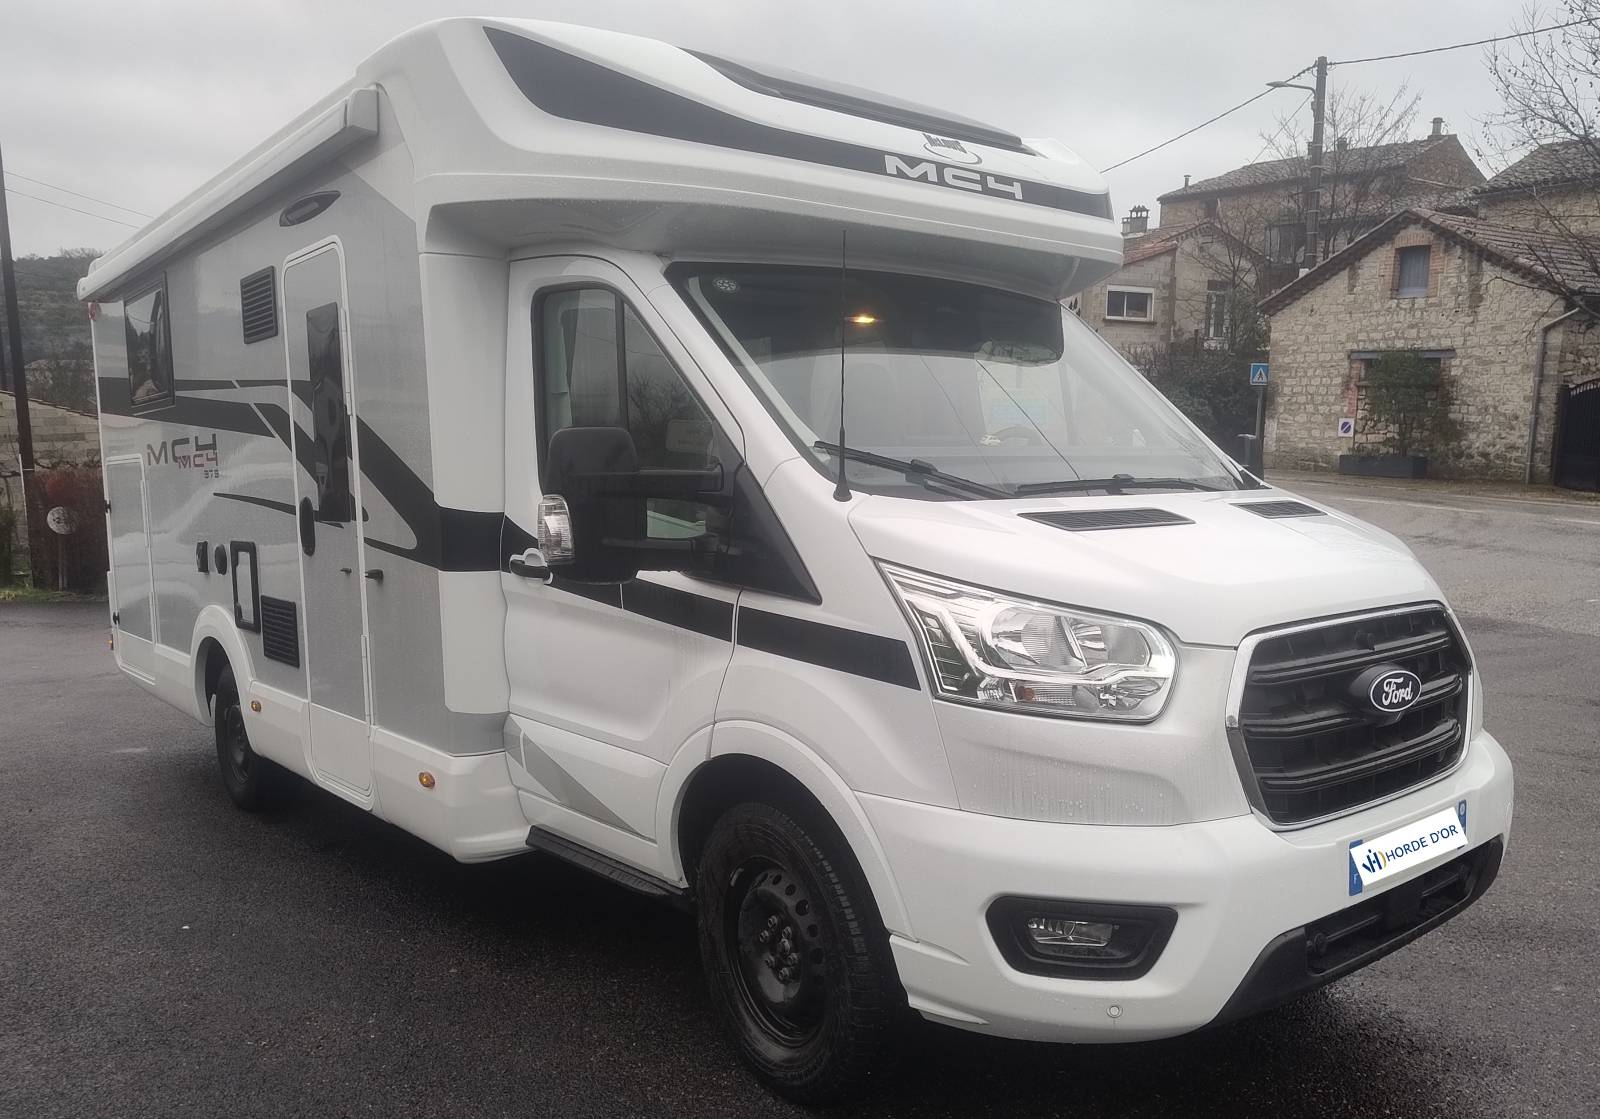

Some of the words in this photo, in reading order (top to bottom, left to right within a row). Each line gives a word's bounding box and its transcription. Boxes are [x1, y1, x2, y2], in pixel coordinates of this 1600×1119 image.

[884, 154, 1023, 200] MC4
[146, 433, 217, 466] MC4
[177, 452, 219, 469] MC4
[1382, 677, 1413, 705] Ford
